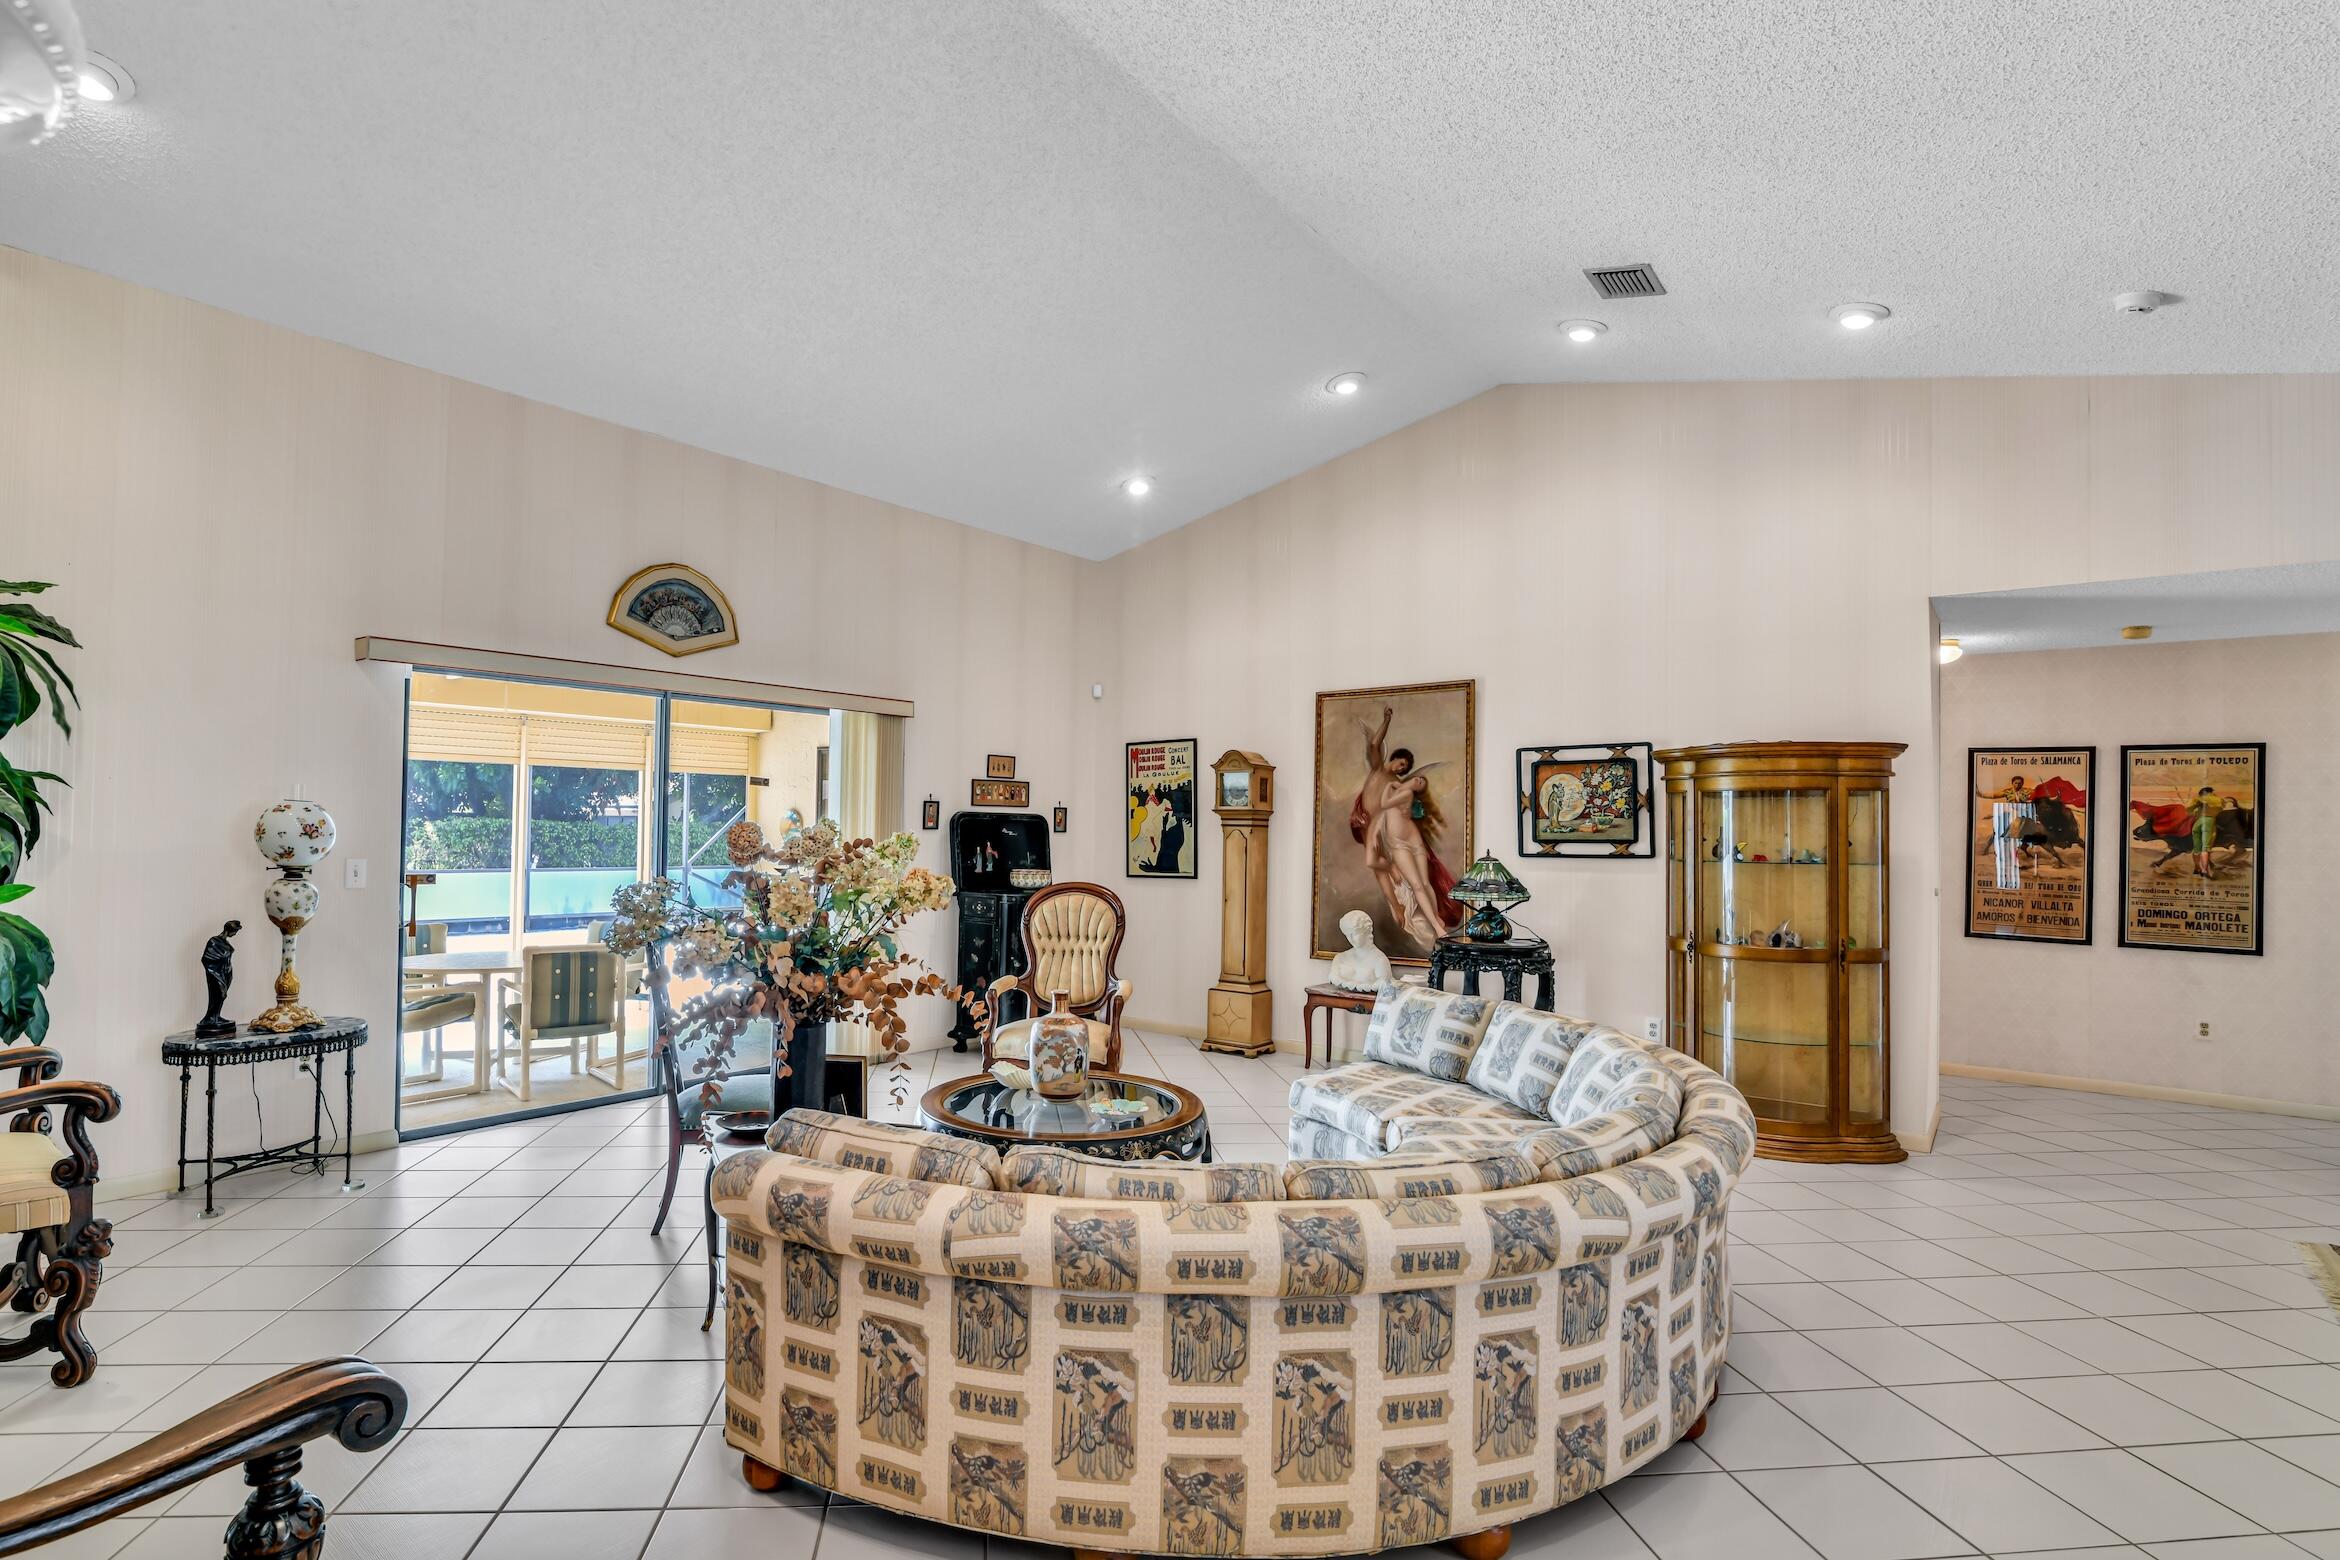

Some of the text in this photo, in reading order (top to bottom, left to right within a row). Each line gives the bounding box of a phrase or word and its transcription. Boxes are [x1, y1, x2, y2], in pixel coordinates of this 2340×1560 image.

[1151, 747, 1166, 755] ROUGE
[1170, 754, 1186, 765] BAL
[1981, 756, 2081, 766] Plaza de Toros de SALAMANCA
[2196, 757, 2205, 765] de
[2209, 757, 2249, 765] TOLEDO
[2174, 888, 2205, 896] Corrida
[2225, 890, 2250, 898] Toros
[1983, 897, 2074, 912] NICANOR VILLALTA
[1976, 911, 2016, 923] AMOROS
[2026, 914, 2080, 927] BIENVENIDA
[2137, 908, 2241, 923] DOMINGO ORTEGA
[2185, 921, 2249, 934] MANOLETE
